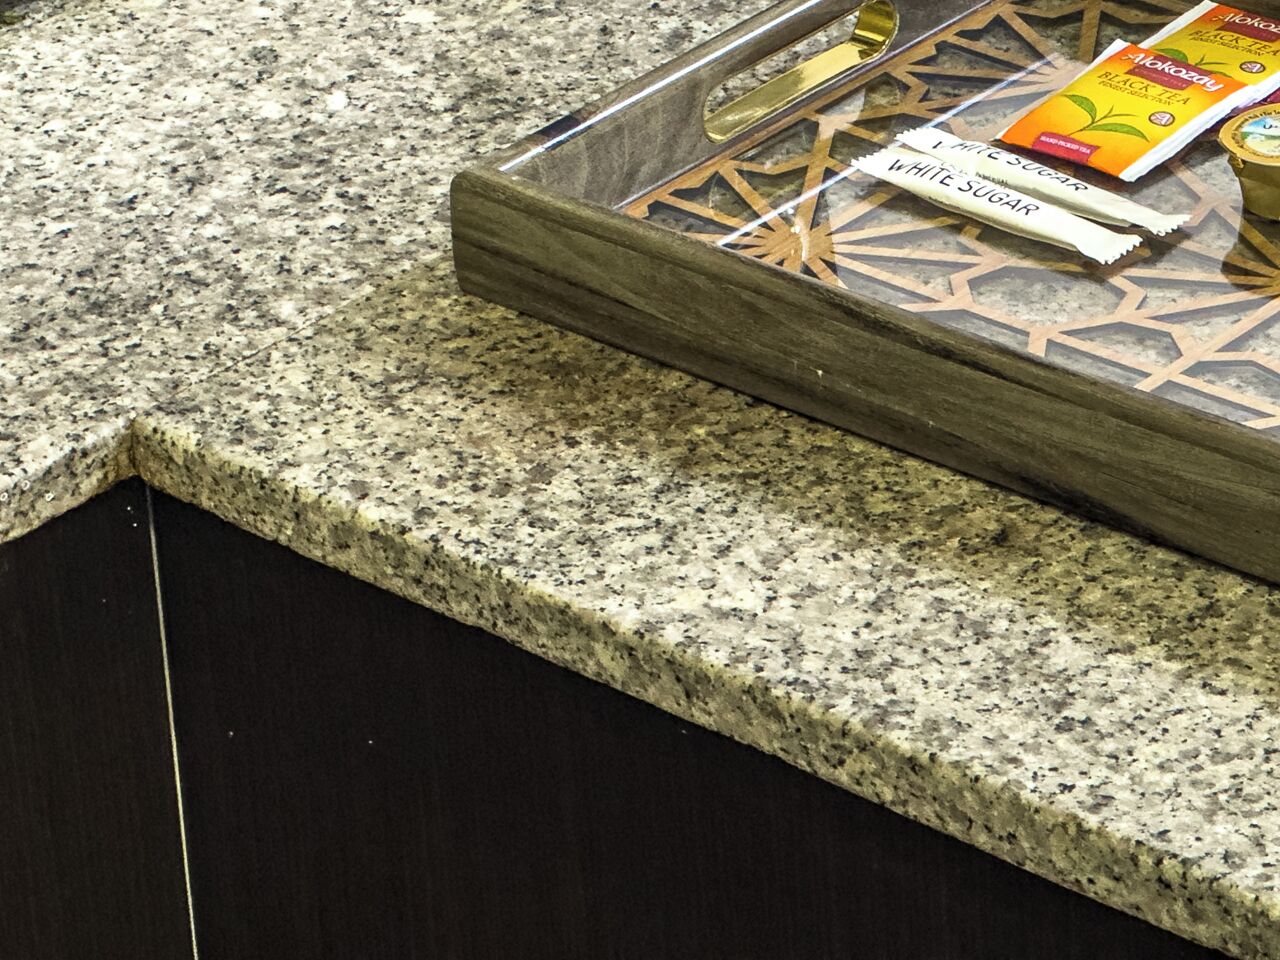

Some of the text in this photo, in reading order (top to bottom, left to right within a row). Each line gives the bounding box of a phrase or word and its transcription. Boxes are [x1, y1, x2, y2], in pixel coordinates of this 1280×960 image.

[1189, 30, 1247, 45] BLACK
[1249, 41, 1280, 57] TEA
[1097, 71, 1157, 94] BLACK
[1160, 89, 1192, 106] TEA
[1121, 52, 1225, 92] Alokozay
[888, 158, 957, 188] WHITE
[957, 178, 1041, 216] SUGAR
[1006, 152, 1089, 192] SUGAR
